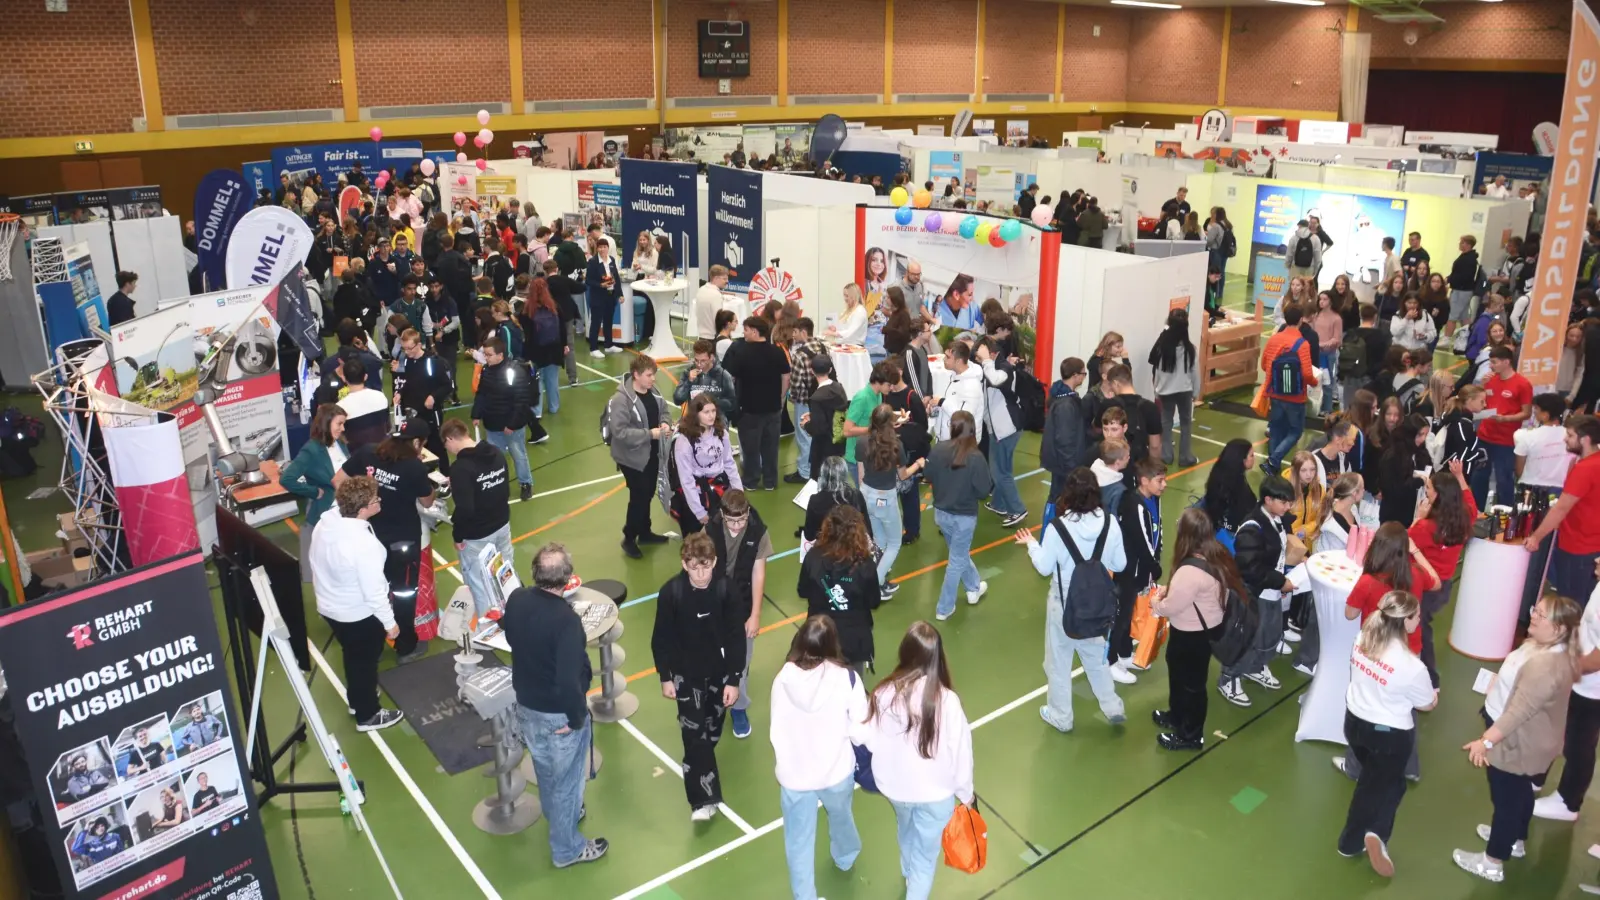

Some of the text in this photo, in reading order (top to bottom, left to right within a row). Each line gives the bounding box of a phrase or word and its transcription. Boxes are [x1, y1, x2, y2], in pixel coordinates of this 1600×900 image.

[324, 151, 345, 161] Fair
[345, 150, 359, 160] ist
[640, 182, 675, 197] Herzlich
[721, 190, 746, 209] Herzlich
[198, 184, 233, 251] DOMMEL
[631, 199, 685, 216] willkommen!
[715, 210, 754, 231] willkommen!
[95, 600, 153, 630] REHART
[98, 617, 141, 642] GMBH
[26, 634, 199, 713] CHOOSE YOUR
[57, 652, 215, 731] AUSBILDUNG!
[210, 875, 242, 895] QR-Code
[212, 872, 225, 884] bei
